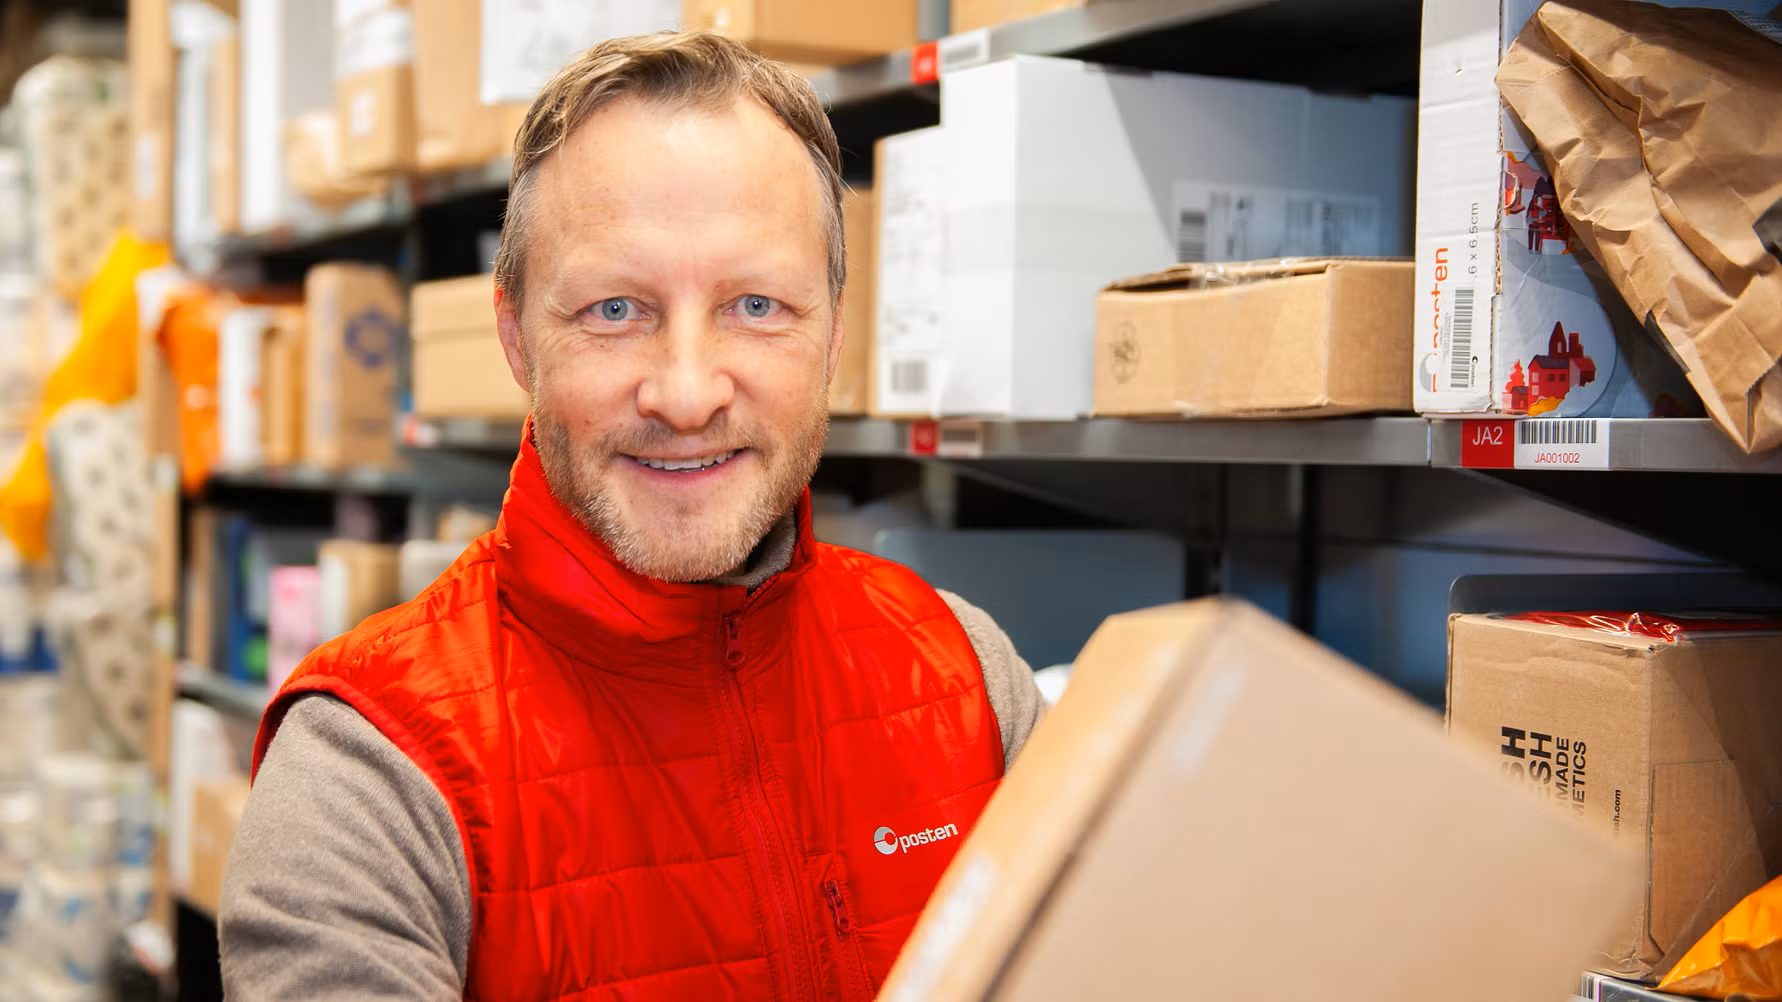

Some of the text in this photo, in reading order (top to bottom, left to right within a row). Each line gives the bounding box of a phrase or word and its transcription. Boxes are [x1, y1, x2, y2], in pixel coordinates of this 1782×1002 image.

[1468, 202, 1479, 249] 6.5cm
[1472, 425, 1504, 446] JA2
[1534, 452, 1580, 464] JA001002
[898, 823, 959, 854] posten
